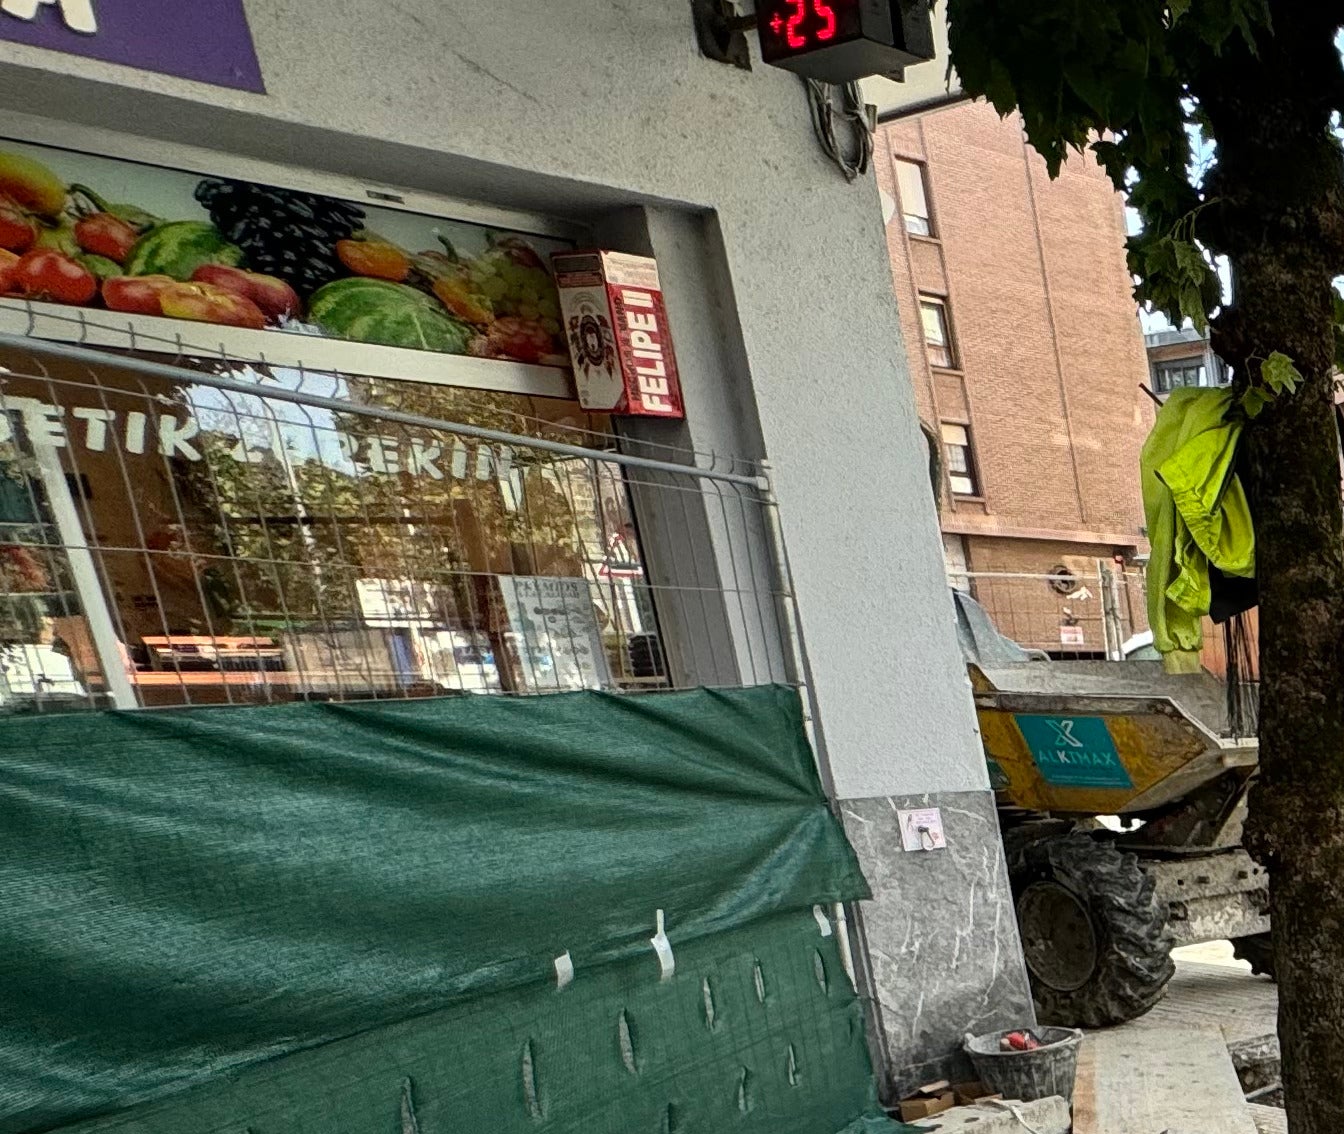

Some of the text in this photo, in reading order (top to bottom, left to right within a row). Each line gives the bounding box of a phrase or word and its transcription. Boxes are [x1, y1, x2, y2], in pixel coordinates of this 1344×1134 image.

[621, 289, 654, 308] II
[627, 311, 672, 411] FELIPE
[0, 399, 202, 462] ETIK
